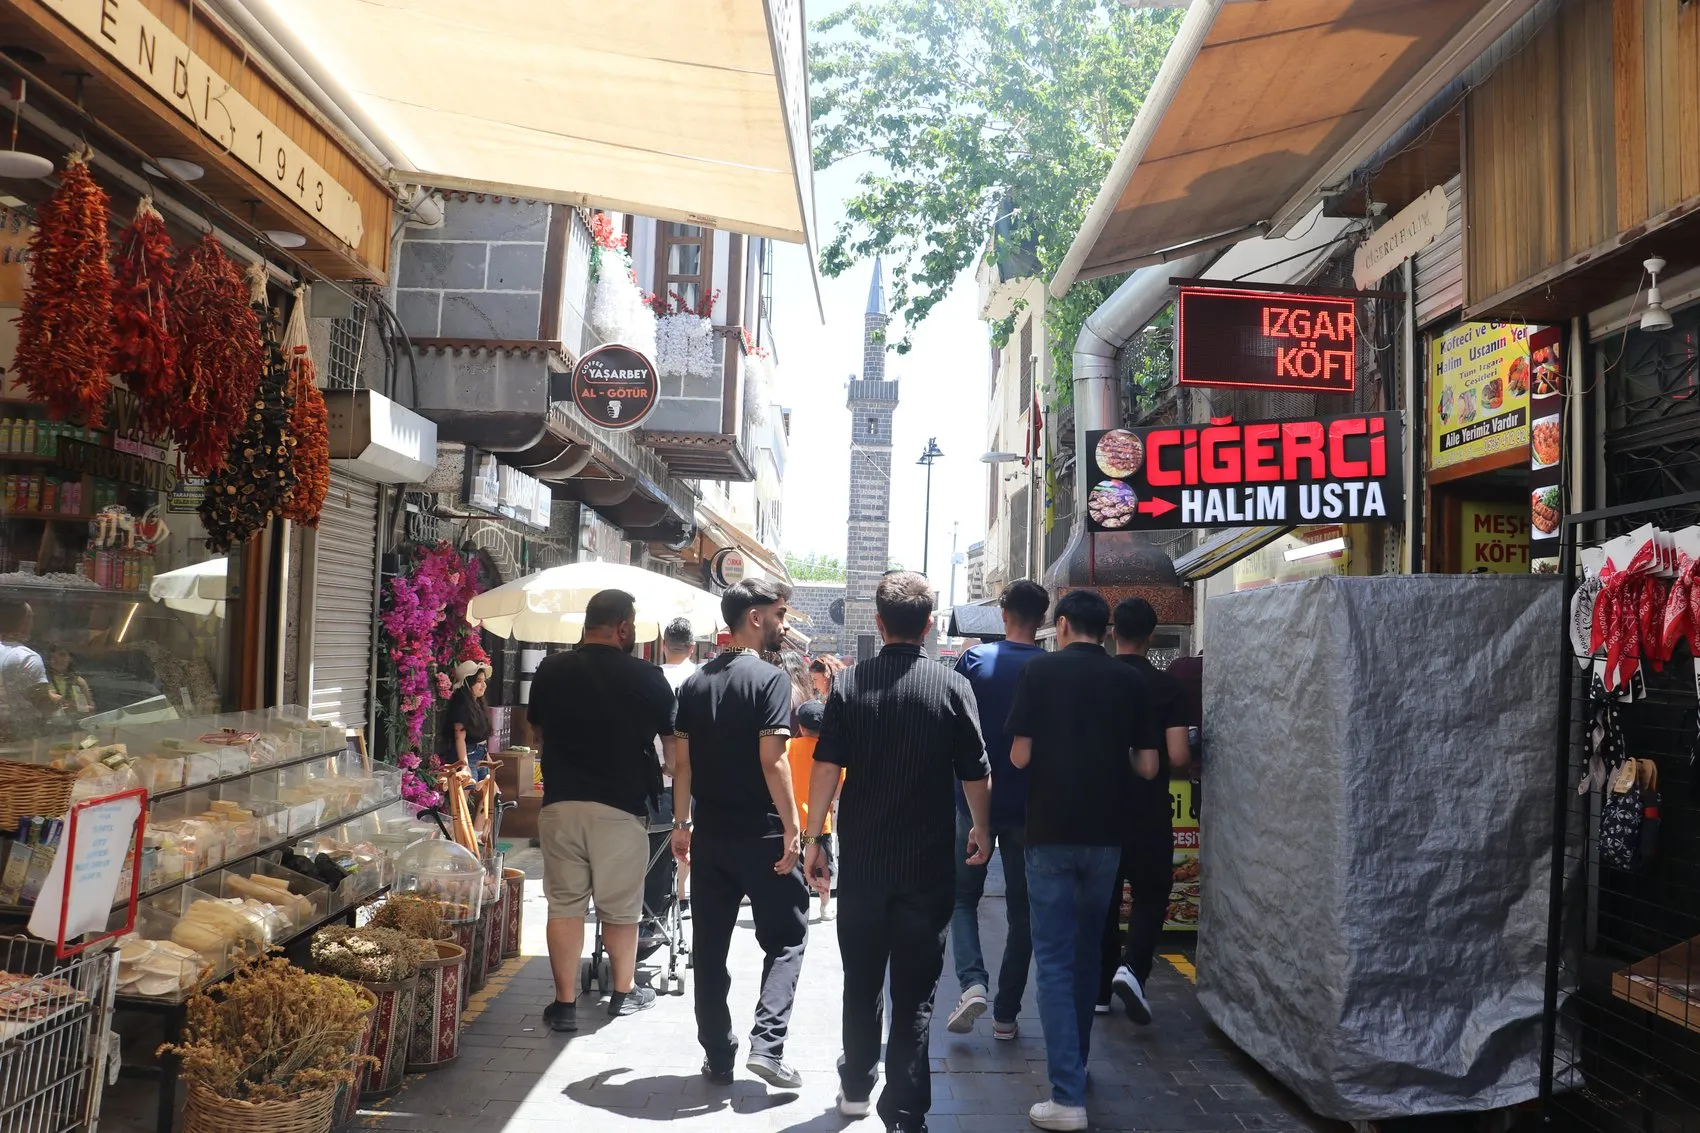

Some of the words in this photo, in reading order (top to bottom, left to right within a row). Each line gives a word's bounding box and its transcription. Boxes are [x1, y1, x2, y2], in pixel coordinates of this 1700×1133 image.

[59, 0, 210, 120] ENDİ
[256, 130, 324, 212] 1943
[1262, 307, 1354, 341] IZGAR
[1440, 328, 1472, 355] Köfteci
[1475, 326, 1486, 338] ve
[581, 360, 604, 374] COFFEE
[1277, 341, 1354, 380] KÖFT
[1436, 356, 1462, 376] Halim
[1469, 337, 1506, 362] Ustanın
[589, 369, 648, 381] YAŞARBEY
[1460, 368, 1477, 380] Tüm
[581, 388, 596, 398] AL
[607, 386, 648, 398] GÖTÜR
[1445, 432, 1460, 449] Aile
[1462, 423, 1490, 443] Yerimiz
[1492, 413, 1519, 434] Vardır
[1299, 481, 1387, 520] USTA
[1475, 540, 1529, 563] KÖFT
